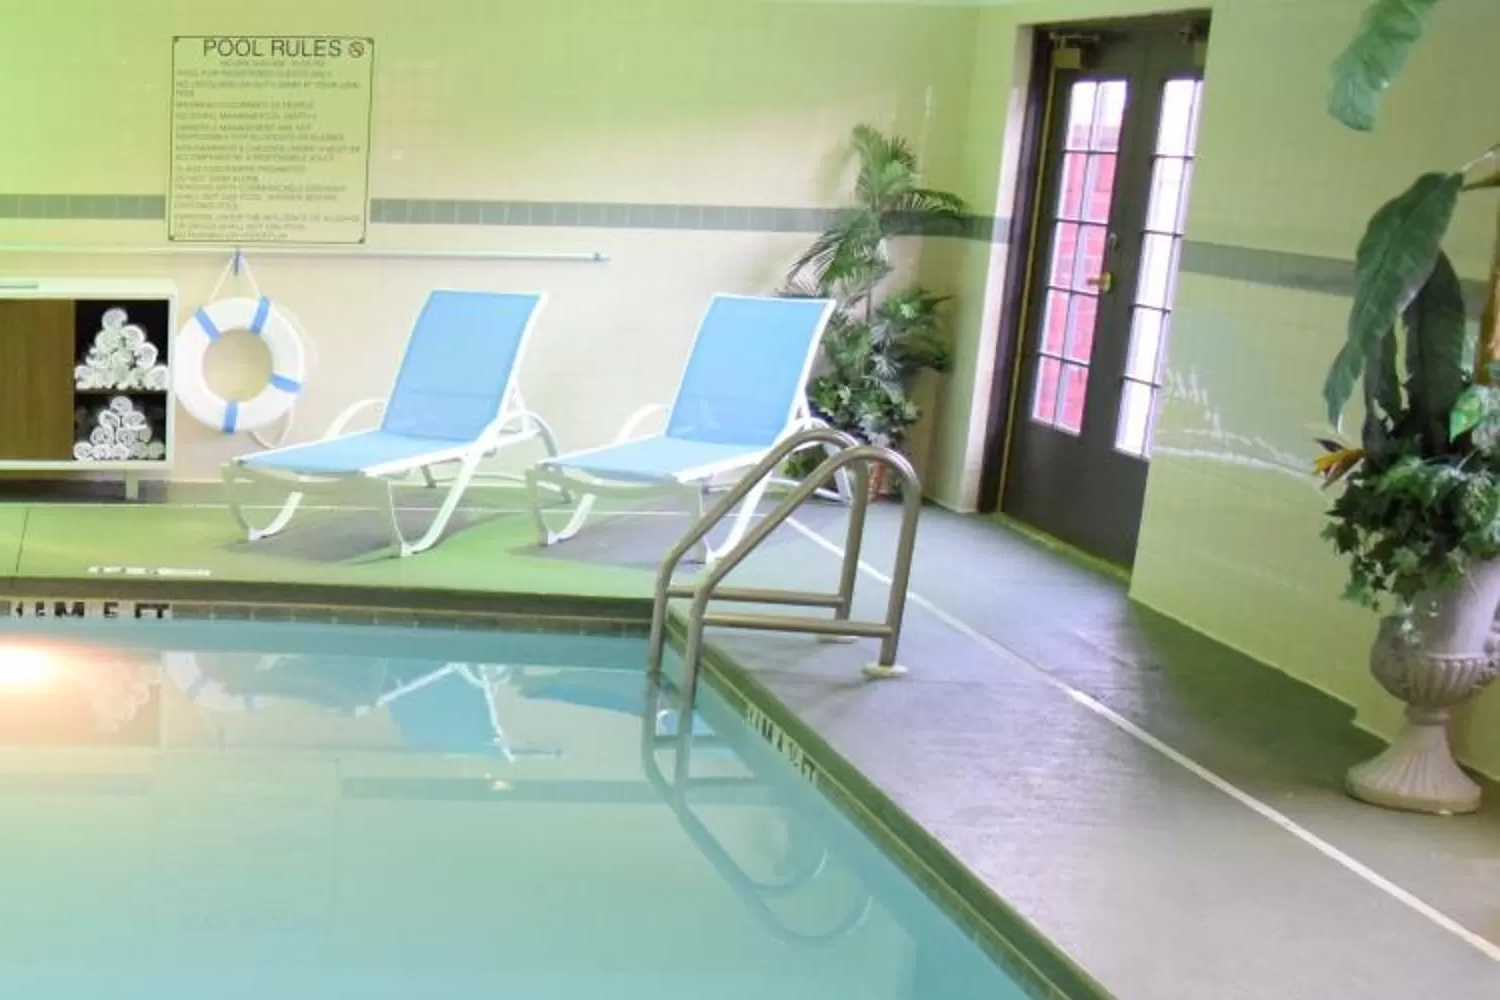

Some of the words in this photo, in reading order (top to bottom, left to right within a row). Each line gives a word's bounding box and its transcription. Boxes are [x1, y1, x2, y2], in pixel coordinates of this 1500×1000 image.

[203, 38, 264, 57] POOL
[271, 39, 342, 57] RULES
[134, 603, 170, 619] FT
